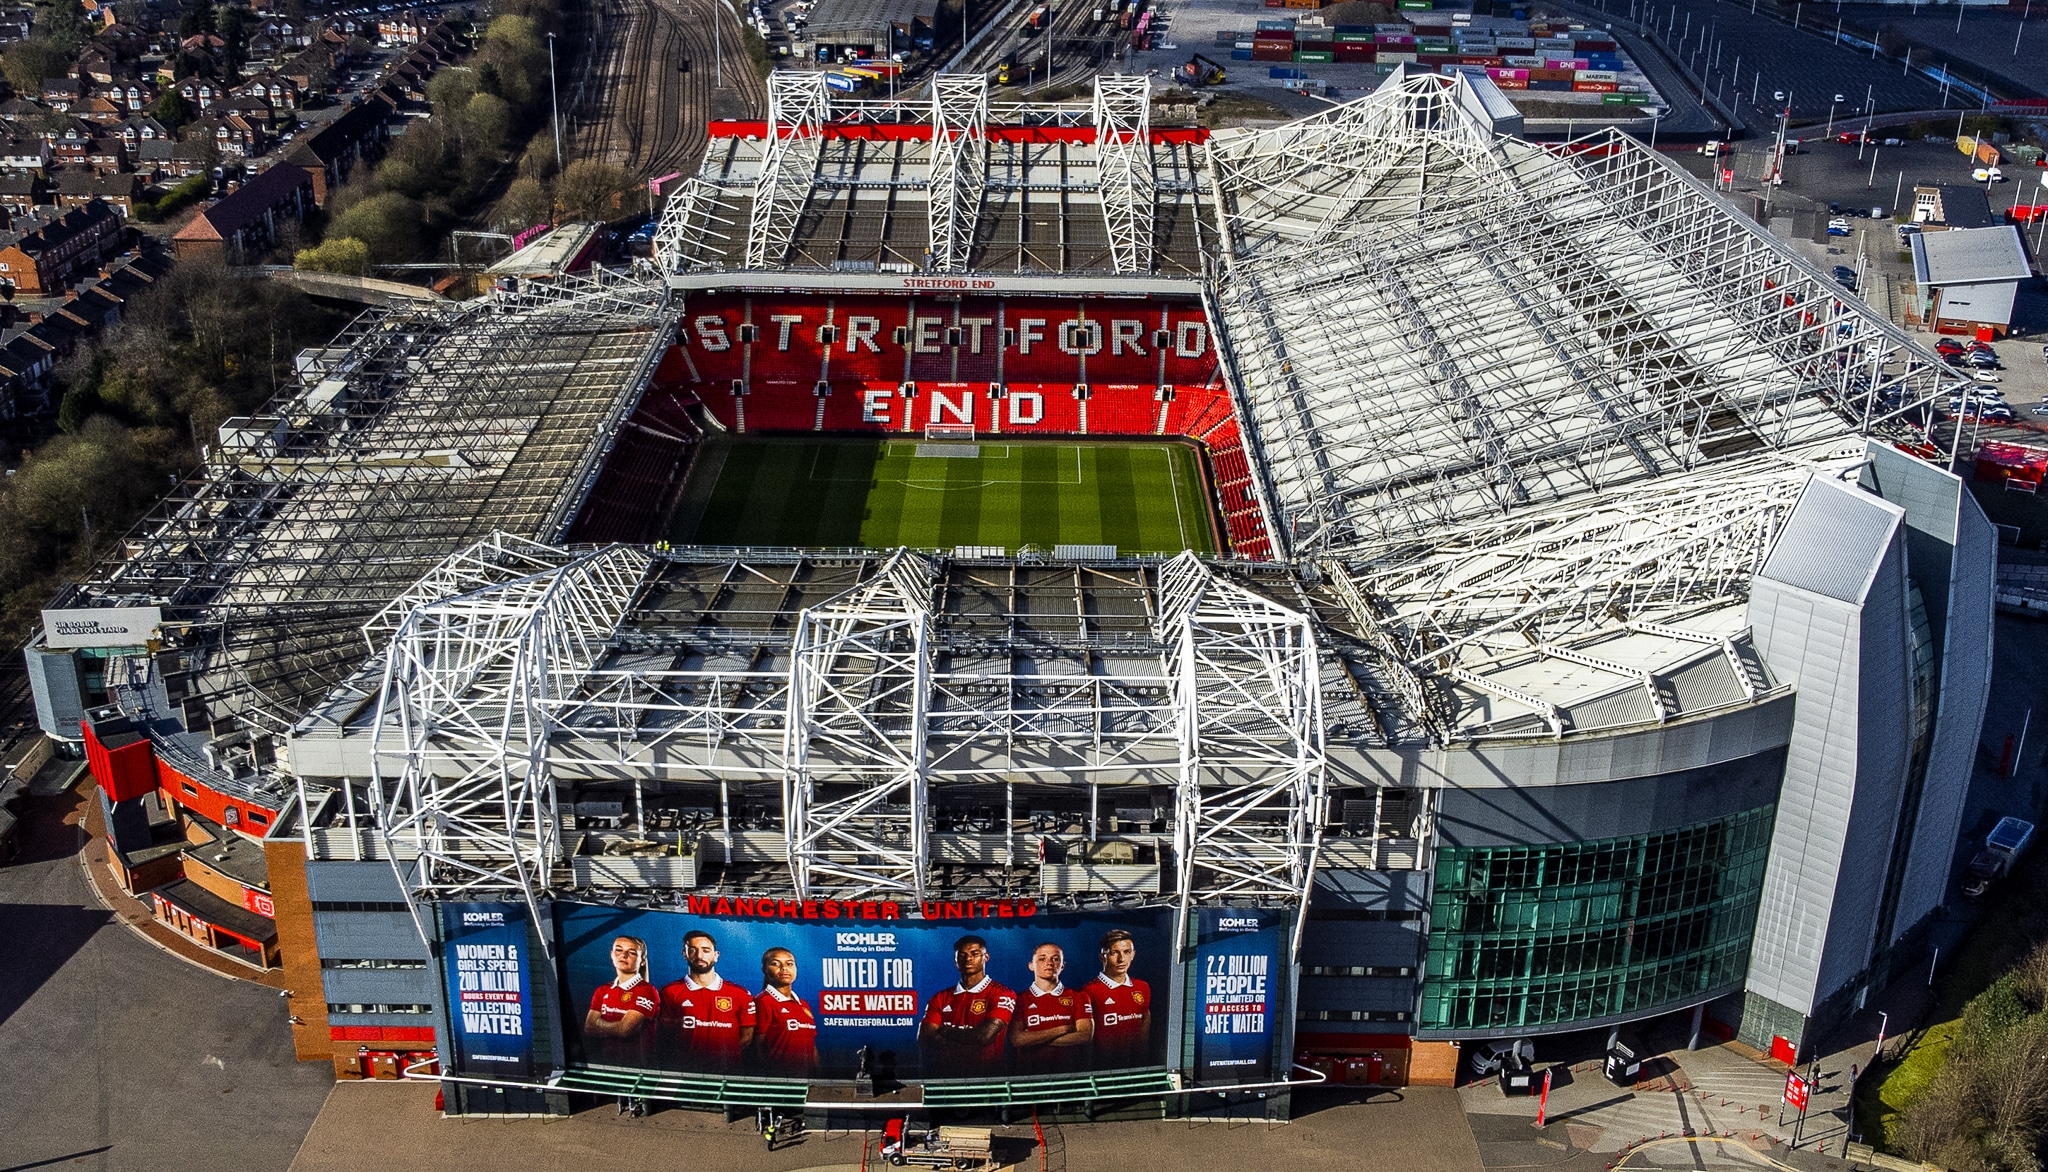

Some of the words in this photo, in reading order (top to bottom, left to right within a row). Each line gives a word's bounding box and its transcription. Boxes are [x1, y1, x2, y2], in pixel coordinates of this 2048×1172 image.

[1560, 61, 1575, 69] ONE
[903, 279, 967, 288] STRETFORD
[972, 280, 995, 289] END
[695, 315, 1207, 358] STRETFORD
[862, 390, 1043, 425] END
[687, 894, 900, 920] MANCHESTER
[922, 898, 1037, 920] UNITED
[463, 912, 504, 922] KOHLER
[1218, 917, 1259, 927] KOHLER
[836, 932, 896, 945] KOHLER
[456, 944, 505, 960] WOMEN
[507, 945, 518, 960] &
[837, 945, 867, 953] Believing
[457, 960, 486, 971] GIRLS
[487, 960, 519, 972] SPEND
[1207, 955, 1226, 976] 2.2
[1228, 955, 1268, 976] BILLION
[822, 958, 878, 988] UNITED
[883, 958, 914, 989] FOR
[459, 971, 478, 992] 200
[481, 971, 520, 992] MILLION
[1205, 975, 1267, 995] PEOPLE
[463, 992, 484, 1000] HOURS
[505, 993, 518, 1001] DAY
[823, 994, 860, 1011] SAFE
[864, 994, 914, 1011] WATER
[1206, 995, 1225, 1004] HAVE
[1226, 994, 1254, 1004] LIMITED
[1255, 994, 1265, 1003] OR
[461, 1001, 522, 1015] COLLECTING
[1252, 1004, 1262, 1012] TO
[462, 1014, 523, 1036] WATER
[824, 1017, 914, 1026] SAFEWATERFORALL.COM
[1205, 1014, 1230, 1034] SAFE
[1232, 1013, 1264, 1033] WATER
